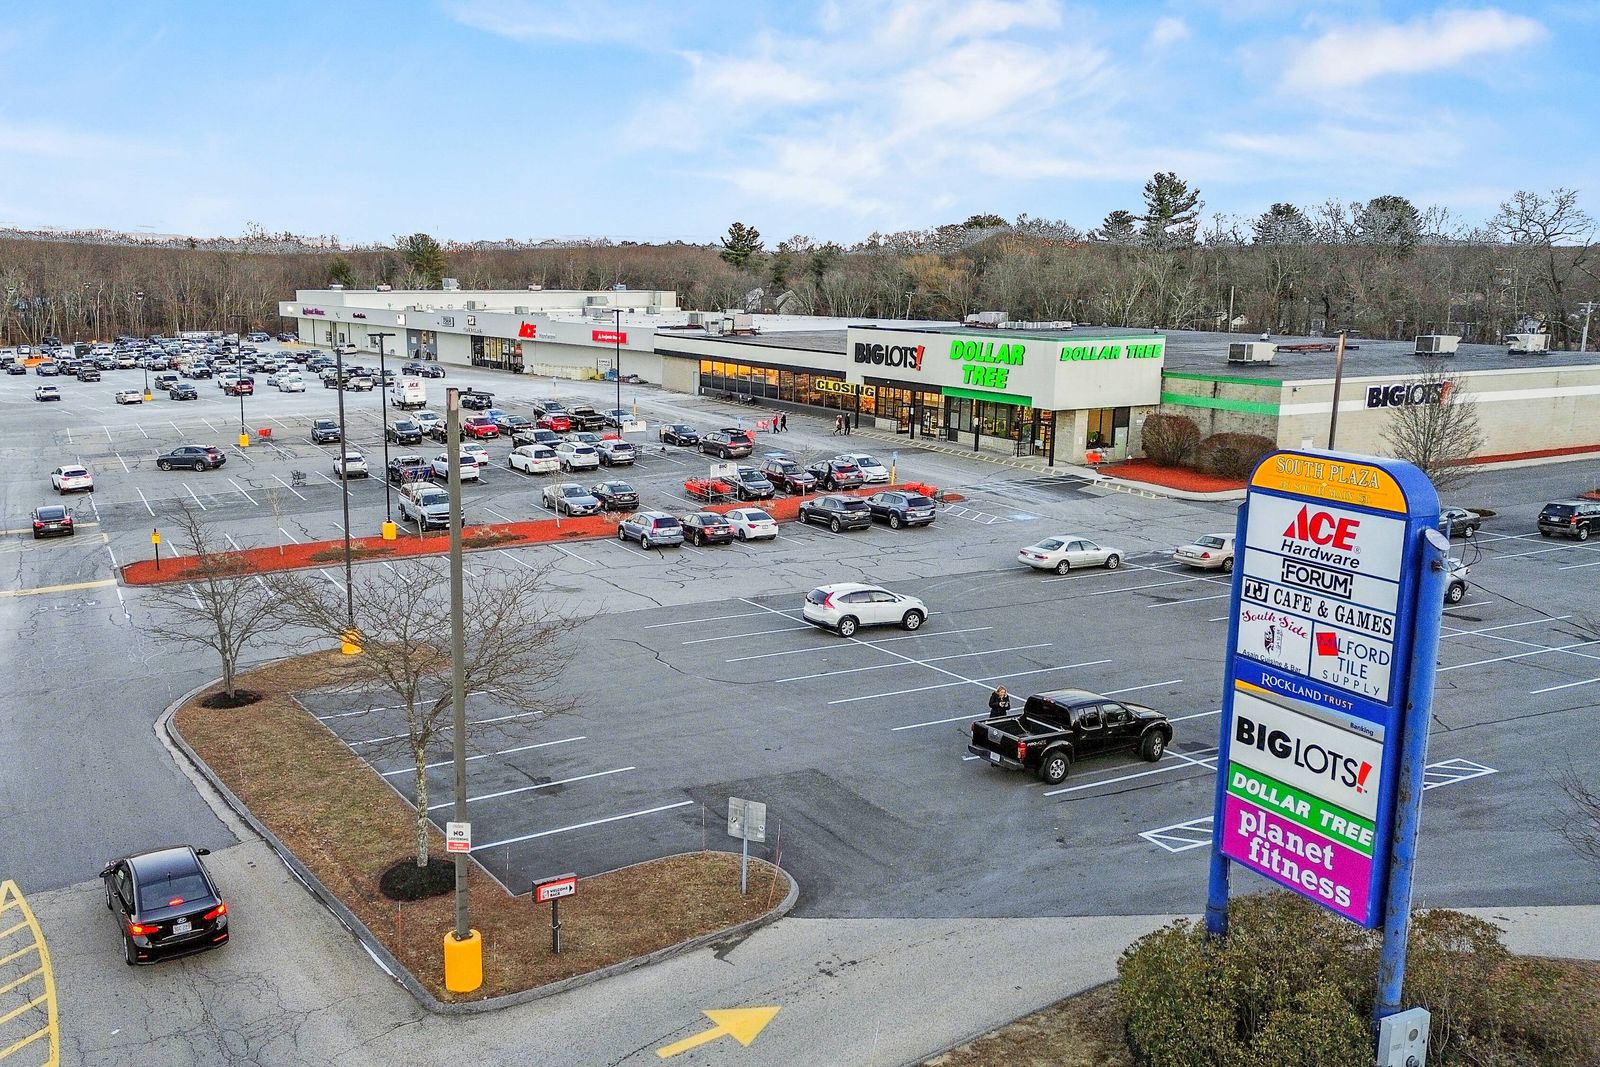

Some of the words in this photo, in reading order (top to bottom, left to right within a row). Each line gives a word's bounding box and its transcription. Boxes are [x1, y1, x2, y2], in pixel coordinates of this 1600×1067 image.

[949, 339, 1026, 366] DOLLAR
[1059, 345, 1121, 362] DOLLAR
[1126, 344, 1163, 359] TREE
[962, 364, 1010, 389] TREE
[1276, 457, 1325, 480] SOUTH
[1329, 465, 1379, 489] PLAZA
[1283, 503, 1361, 552] ACE
[1280, 538, 1360, 569] Hardware
[1285, 564, 1349, 595] FORUM
[1246, 580, 1269, 601] TJ
[1273, 588, 1312, 614] CAFE
[1317, 600, 1329, 618] &
[1335, 604, 1393, 636] GAMES
[1242, 610, 1276, 623] South
[1279, 616, 1308, 640] Side
[1322, 669, 1380, 696] SUPPLY
[1337, 656, 1368, 680] TILE
[1261, 672, 1322, 701] ROCKLAND
[1323, 693, 1353, 711] TRUST
[1350, 722, 1375, 738] Banking
[1232, 771, 1311, 820] DOLLAR
[1320, 809, 1374, 847] TREE
[1238, 809, 1335, 871] planet
[1248, 836, 1351, 908] fitness
